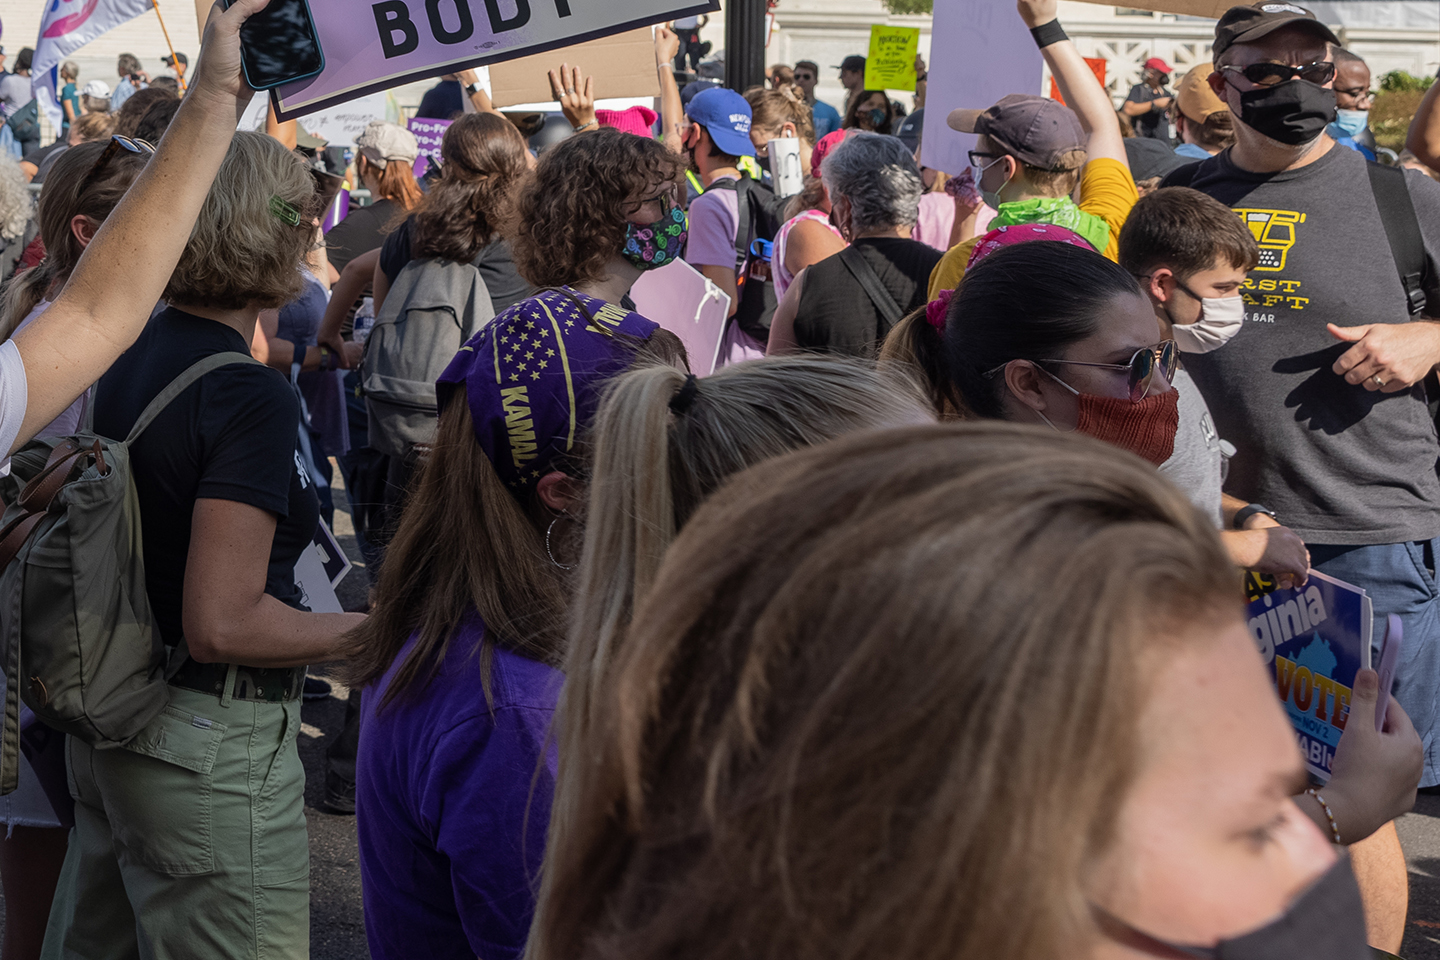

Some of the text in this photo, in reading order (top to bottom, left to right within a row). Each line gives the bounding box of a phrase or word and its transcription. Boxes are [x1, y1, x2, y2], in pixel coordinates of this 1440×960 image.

[1252, 312, 1275, 323] BAR
[1275, 654, 1352, 732] VOTE
[1302, 716, 1322, 735] NOV
[1322, 726, 1329, 739] 2
